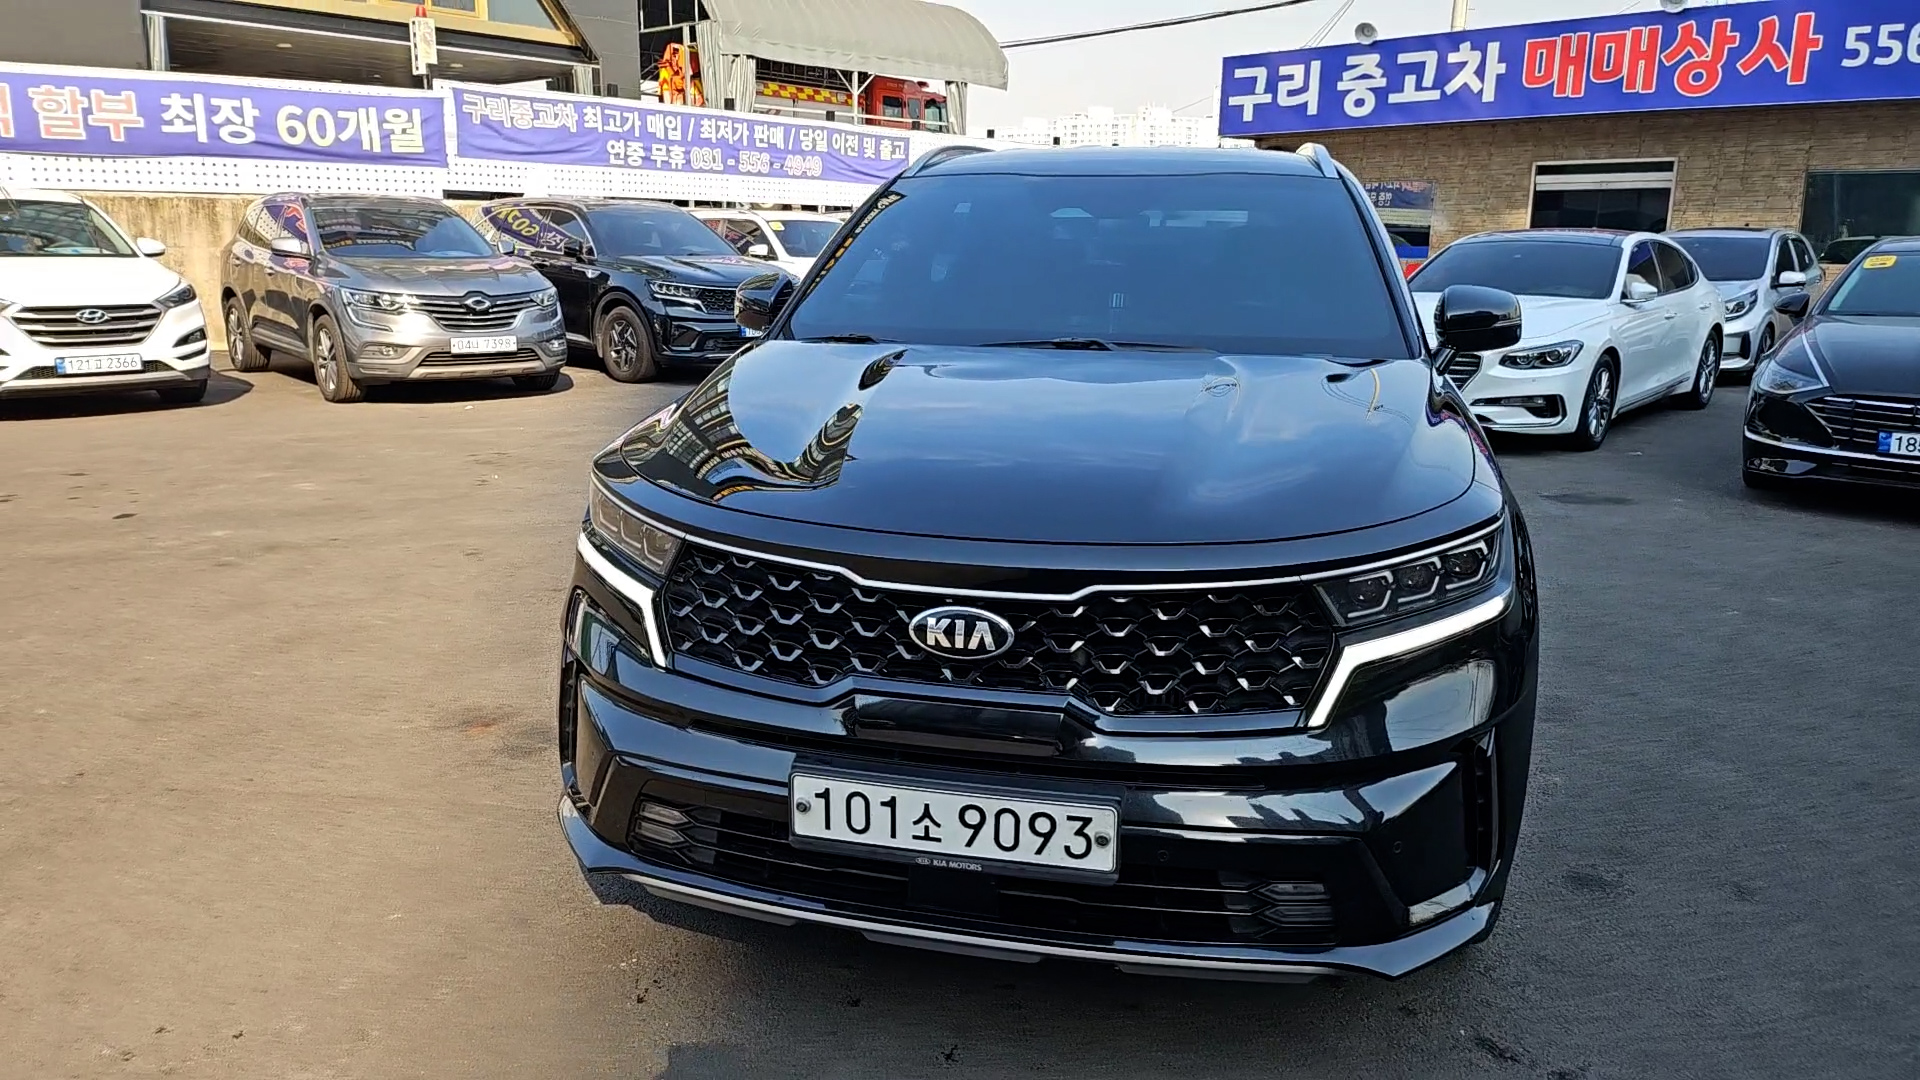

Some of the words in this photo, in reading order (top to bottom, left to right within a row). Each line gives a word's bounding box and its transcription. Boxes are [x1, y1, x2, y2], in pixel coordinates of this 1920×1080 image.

[1228, 60, 1321, 122] 구리
[1336, 40, 1505, 118] 중고차
[1522, 12, 1823, 99] 매매상사
[27, 84, 144, 142] 할부
[160, 92, 260, 144] 최장
[276, 105, 425, 154] 60개월
[462, 93, 578, 133] 구리중고차
[583, 105, 641, 138] 최고가
[647, 113, 682, 141] 매입
[687, 117, 695, 142] /
[700, 118, 750, 146] 최저가
[753, 124, 784, 150] 판매
[788, 127, 796, 151] /
[800, 128, 828, 153] 당일
[832, 132, 858, 157] 이전
[863, 137, 876, 160] 및
[879, 139, 906, 161] 출고
[606, 139, 646, 167] 연중
[650, 143, 686, 169] 무휴
[690, 147, 723, 171] 031
[738, 150, 770, 174] 556
[783, 154, 823, 177] 4949
[107, 357, 137, 369] 2366
[1895, 436, 1920, 453] 18
[926, 617, 996, 651] KIA
[814, 787, 942, 843] 101소
[958, 803, 1094, 860] 9093
[933, 859, 947, 867] KIA
[948, 861, 982, 871] MOTORS
